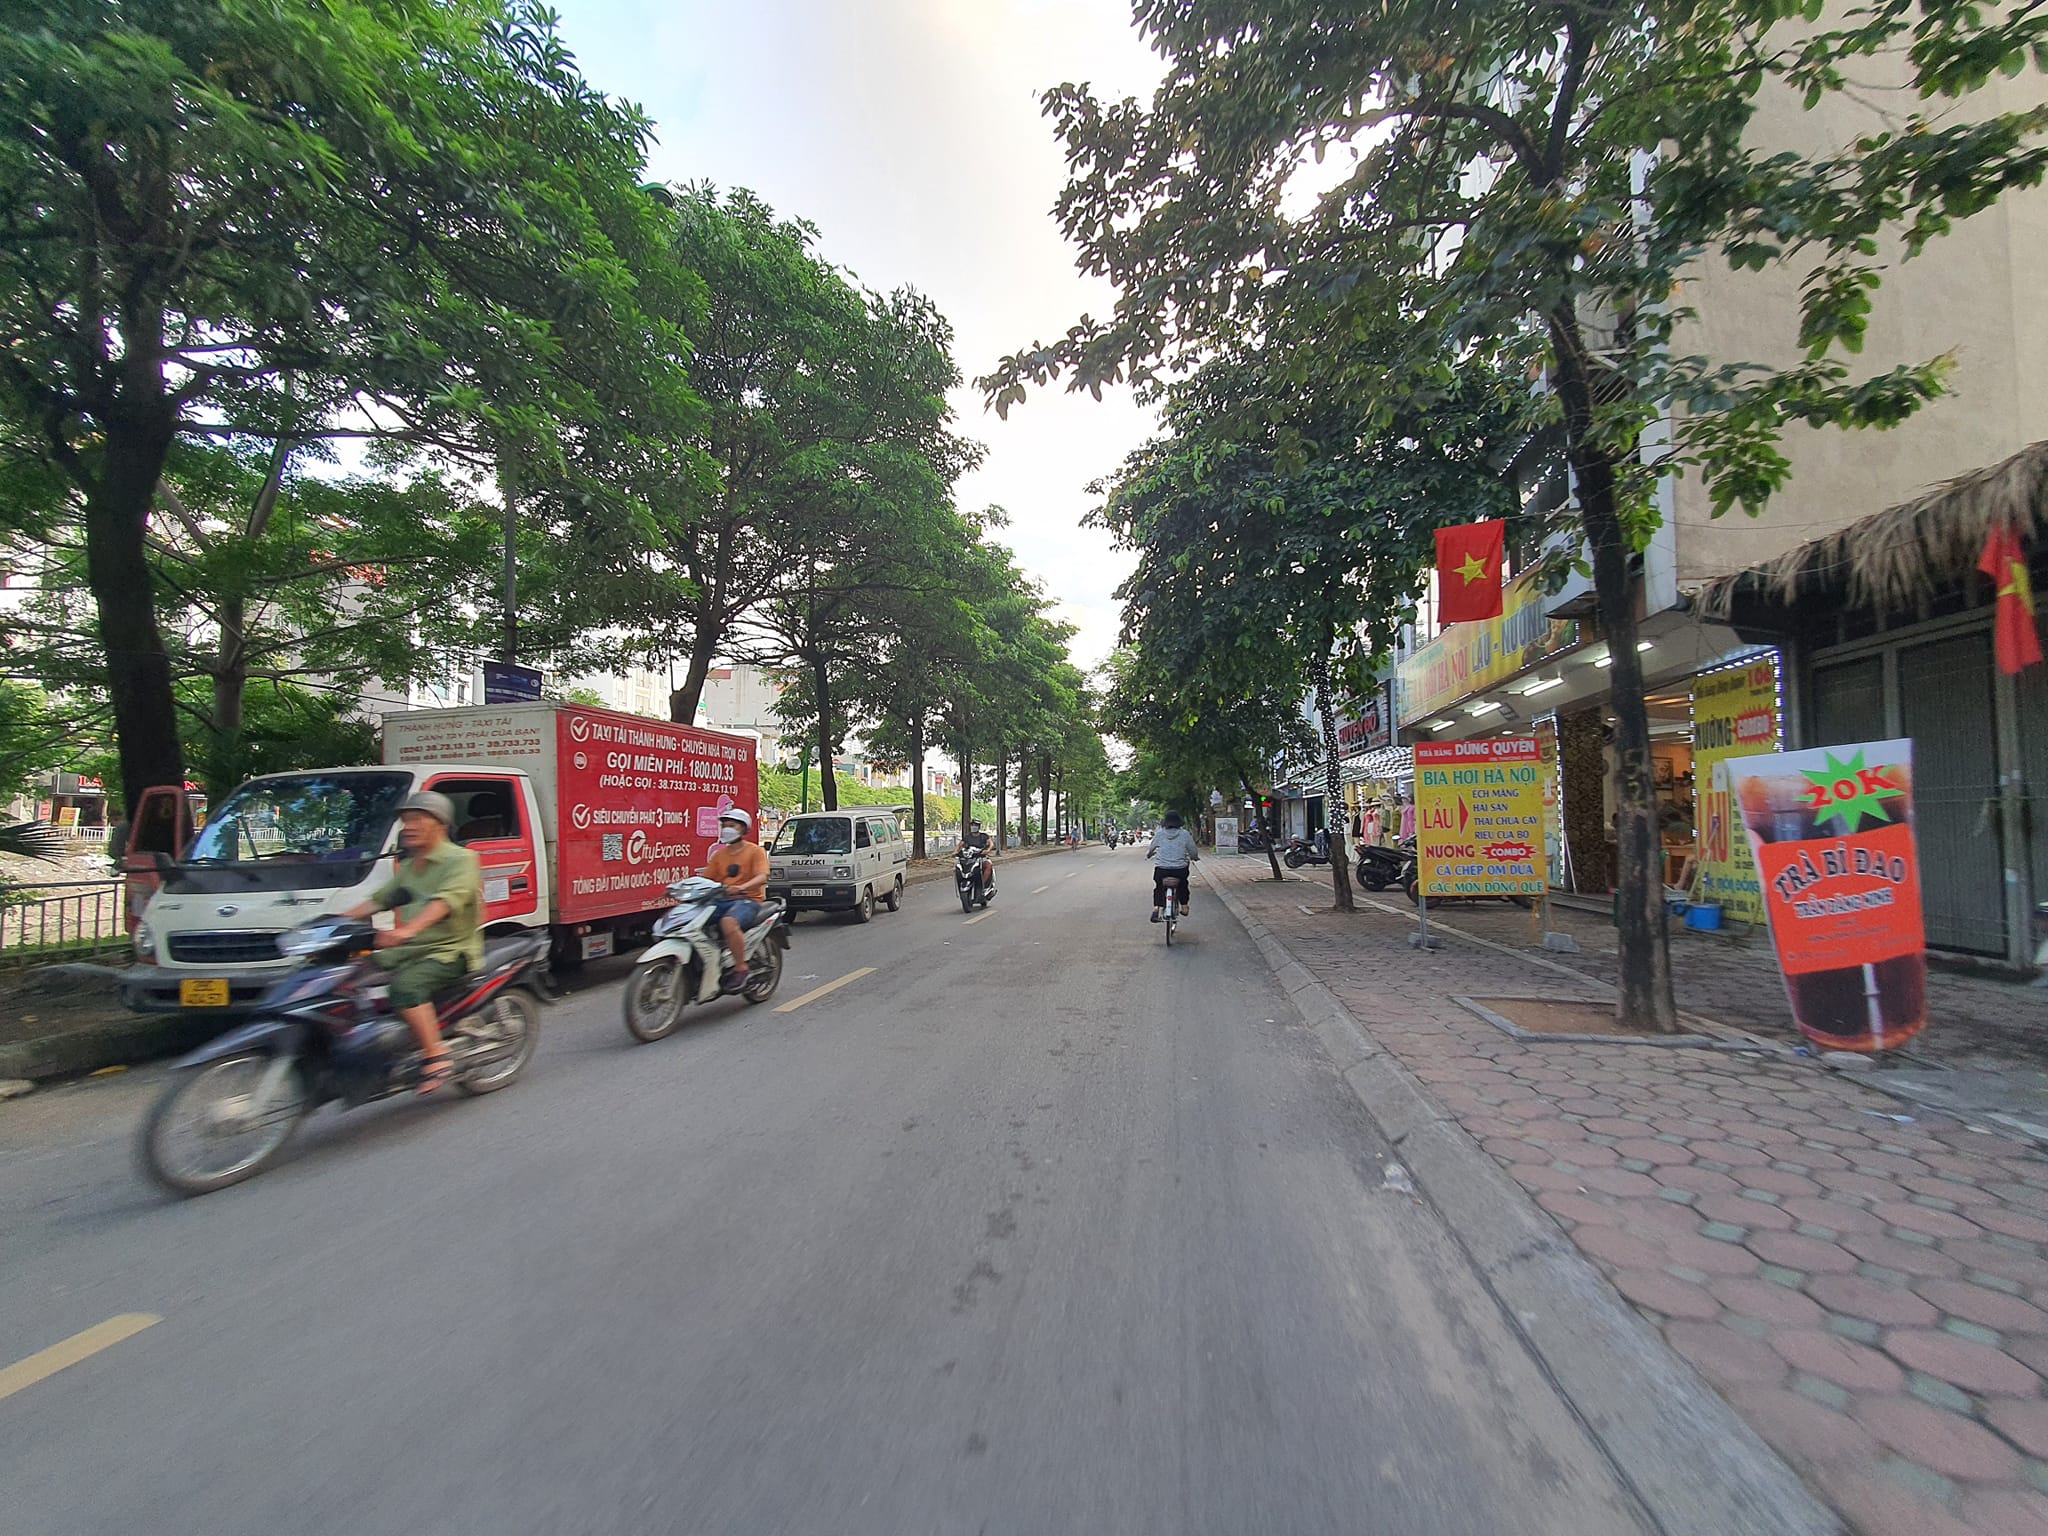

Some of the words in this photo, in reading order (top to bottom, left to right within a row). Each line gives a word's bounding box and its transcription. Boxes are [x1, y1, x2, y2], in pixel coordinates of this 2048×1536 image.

[592, 723, 611, 740] TAXI
[614, 725, 626, 743] TẢI
[628, 729, 655, 747] THÀNH
[656, 732, 676, 750] HƯNG
[1455, 741, 1489, 756] DŨNG
[607, 752, 631, 773] GỌI
[634, 749, 663, 773] MIỄN
[689, 760, 735, 781] 1800.00.33
[1424, 771, 1448, 786] BIA
[1453, 769, 1479, 785] HƠI
[1484, 764, 1505, 783] HÀ
[1510, 763, 1536, 786] NỘI
[599, 774, 632, 788] (HOẶC
[634, 776, 651, 790] GỌI
[658, 780, 697, 792] 38.733.733
[702, 783, 738, 796] 38.73.13.13)
[1804, 765, 1897, 809] 20K
[593, 808, 611, 824] SIÊU
[656, 808, 663, 828] 3
[1423, 797, 1453, 829] LẨU
[627, 830, 691, 865] CityExpress
[1491, 848, 1527, 857] COMBO
[791, 859, 826, 867] SUZUKI
[1774, 849, 1821, 903] TRÀ
[1822, 841, 1850, 877] BÍ
[1854, 848, 1907, 885] ĐAO
